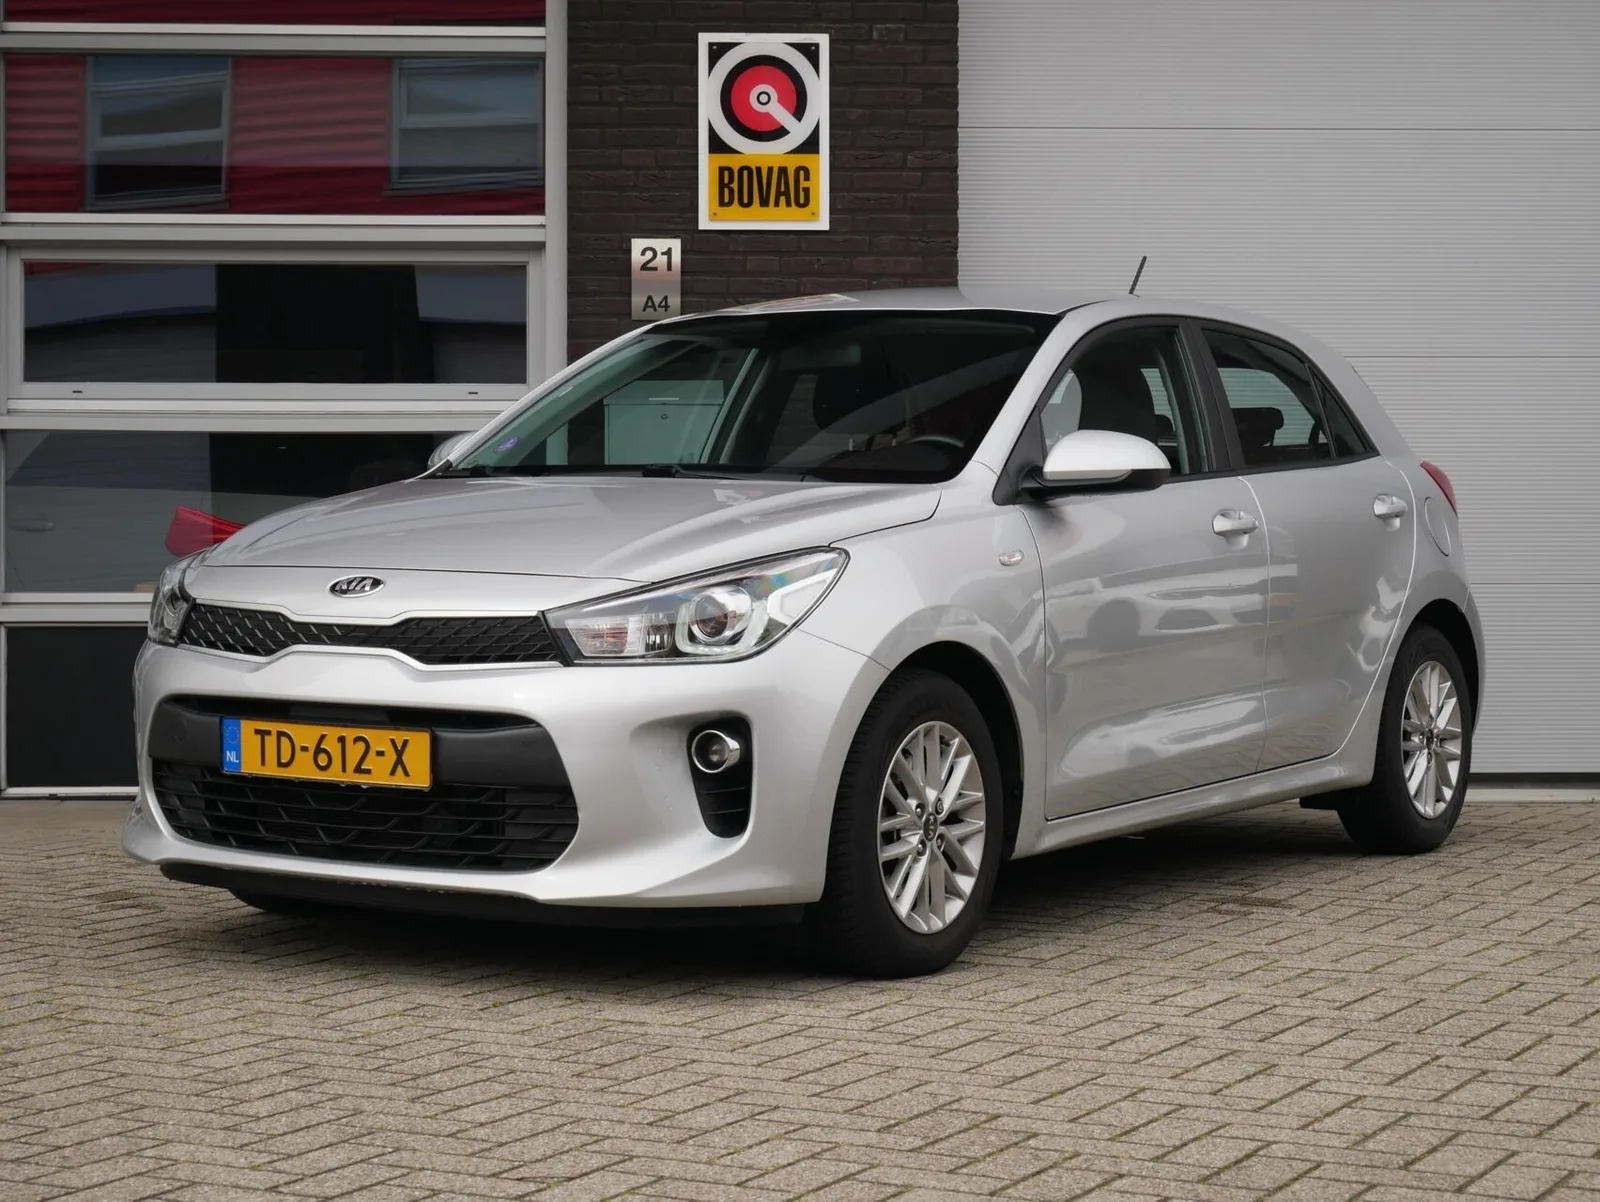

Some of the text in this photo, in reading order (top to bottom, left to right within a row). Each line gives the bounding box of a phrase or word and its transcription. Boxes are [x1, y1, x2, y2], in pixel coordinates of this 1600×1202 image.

[718, 165, 811, 208] BOVAG
[640, 246, 673, 271] 21
[642, 295, 670, 312] A4
[334, 577, 374, 591] KIA
[226, 750, 239, 763] NL
[254, 728, 410, 777] TD-612-X
